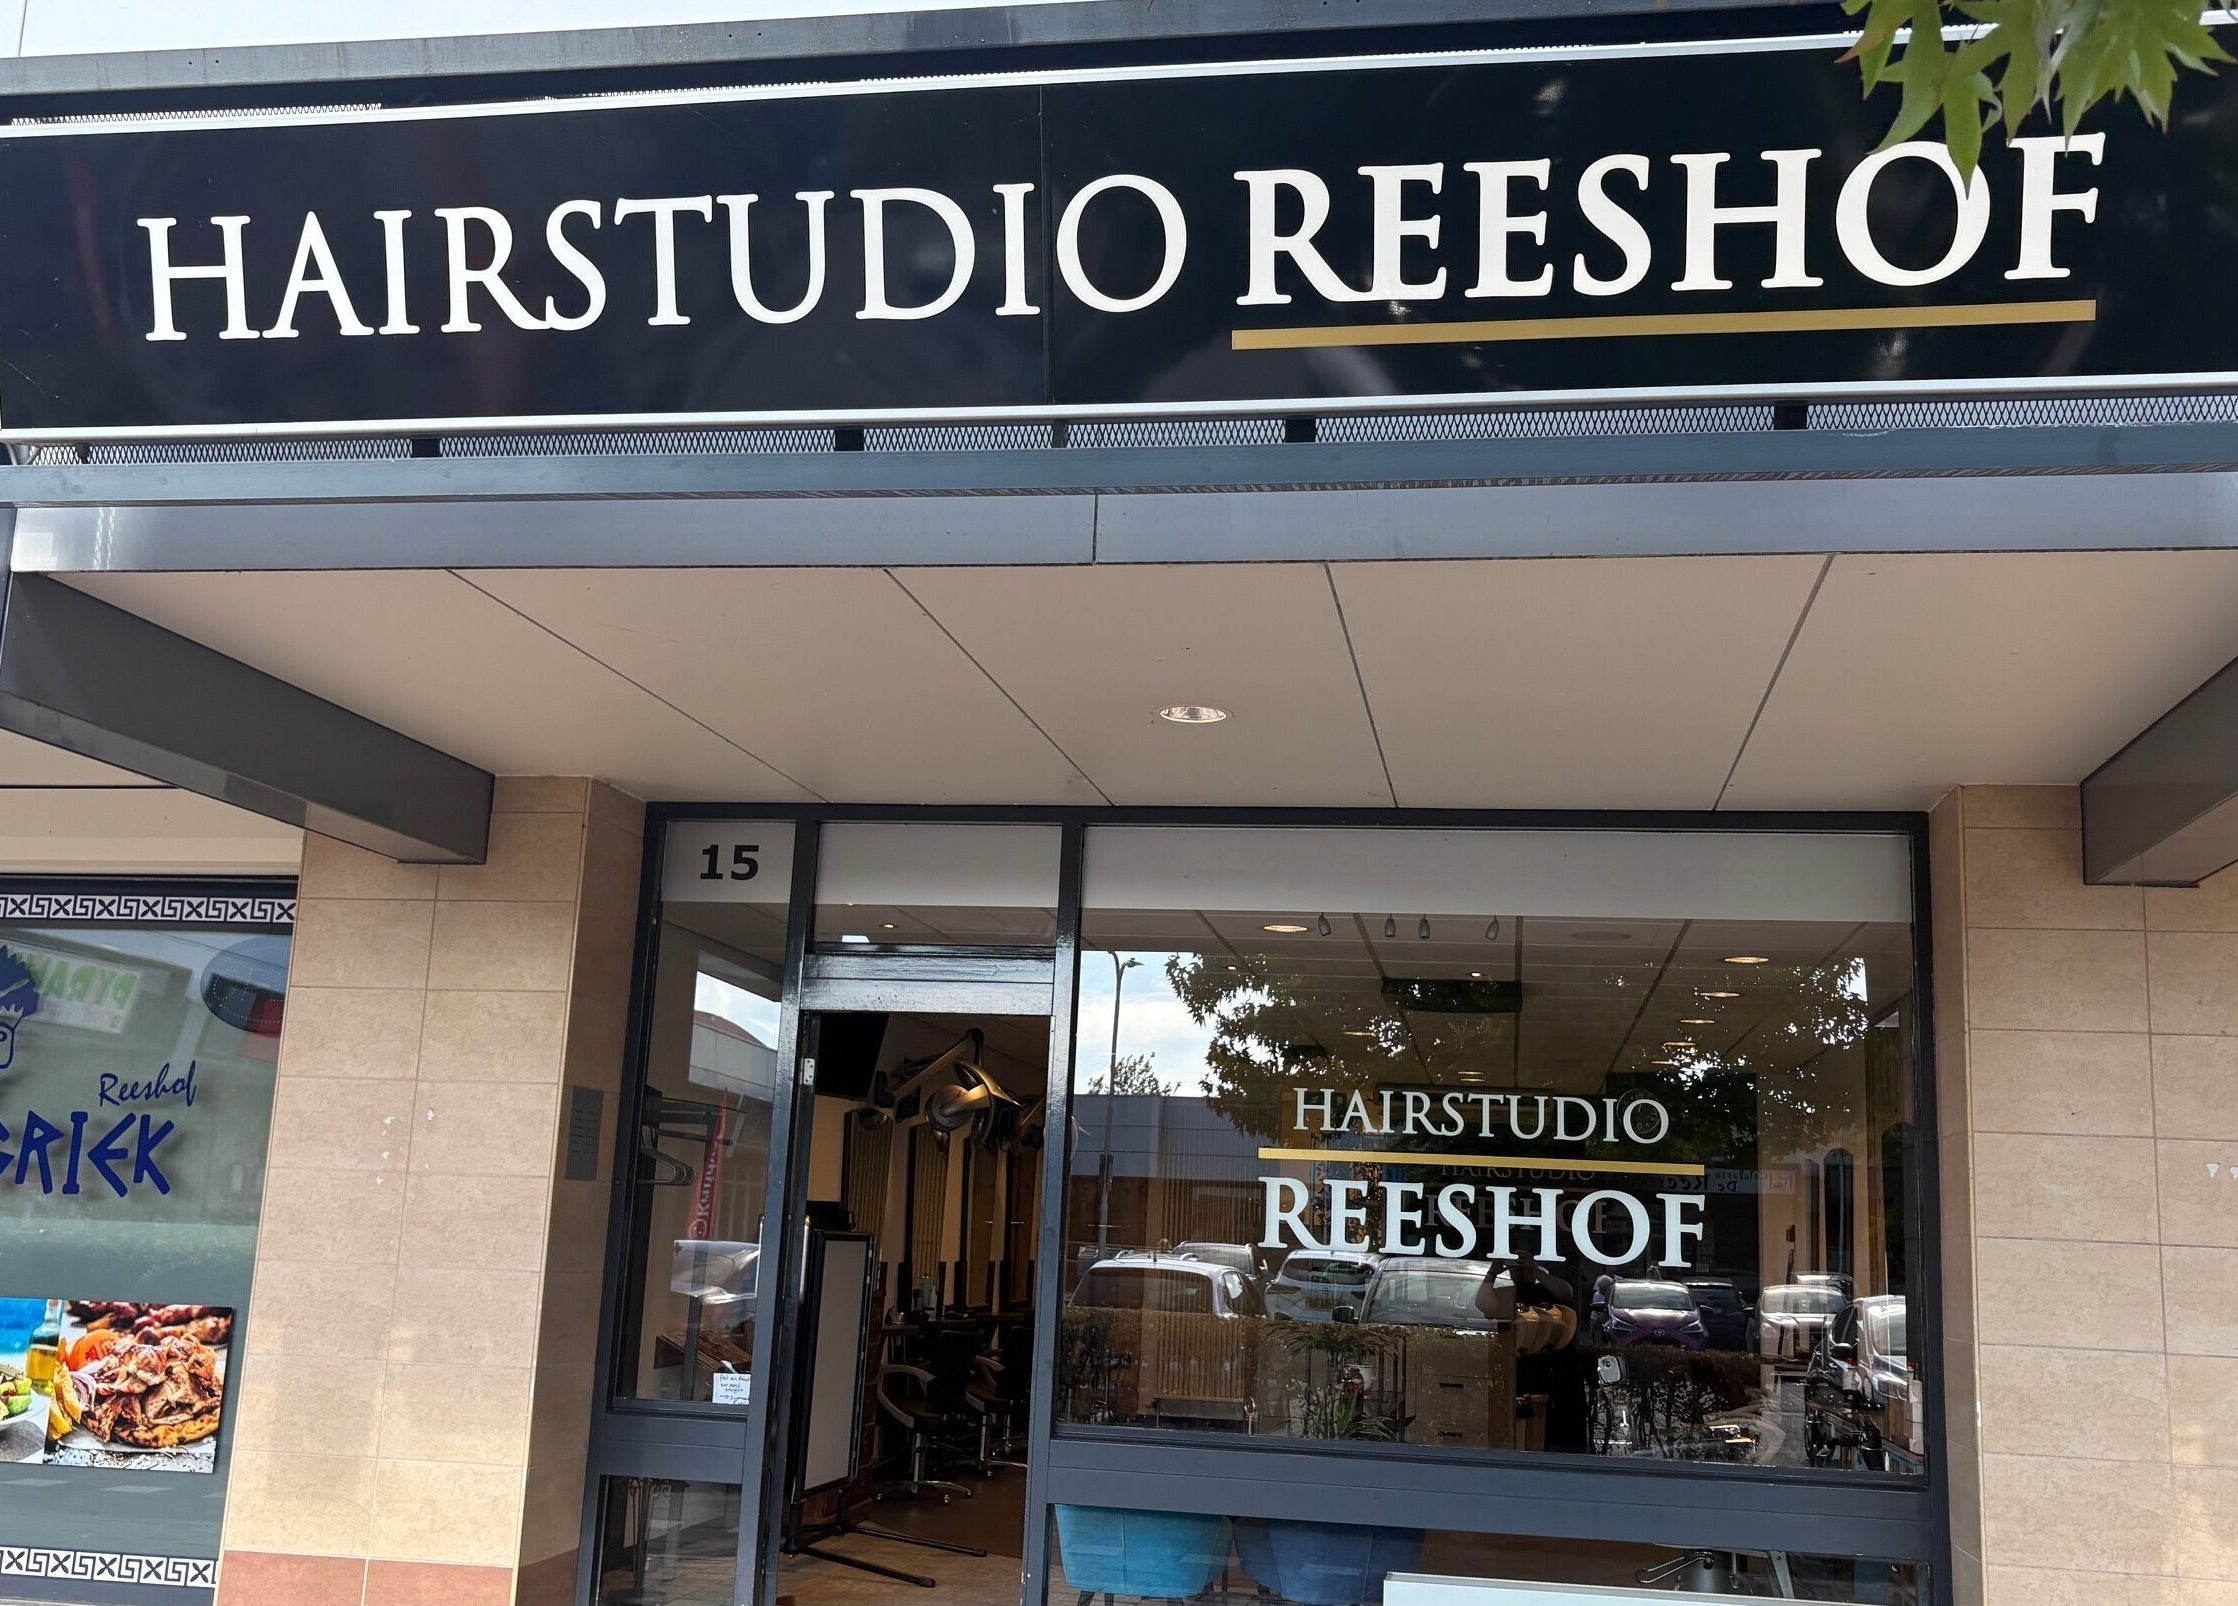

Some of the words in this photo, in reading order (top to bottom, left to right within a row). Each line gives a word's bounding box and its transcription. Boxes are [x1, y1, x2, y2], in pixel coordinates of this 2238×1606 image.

[136, 173, 1188, 342] HAIRSTUDIO
[1233, 131, 2106, 306] REESHOF
[699, 843, 760, 881] 15
[99, 1059, 197, 1108] Reeshof
[1293, 1087, 1669, 1144] HAIRSTUDIO
[1258, 1175, 1707, 1268] REESHOF
